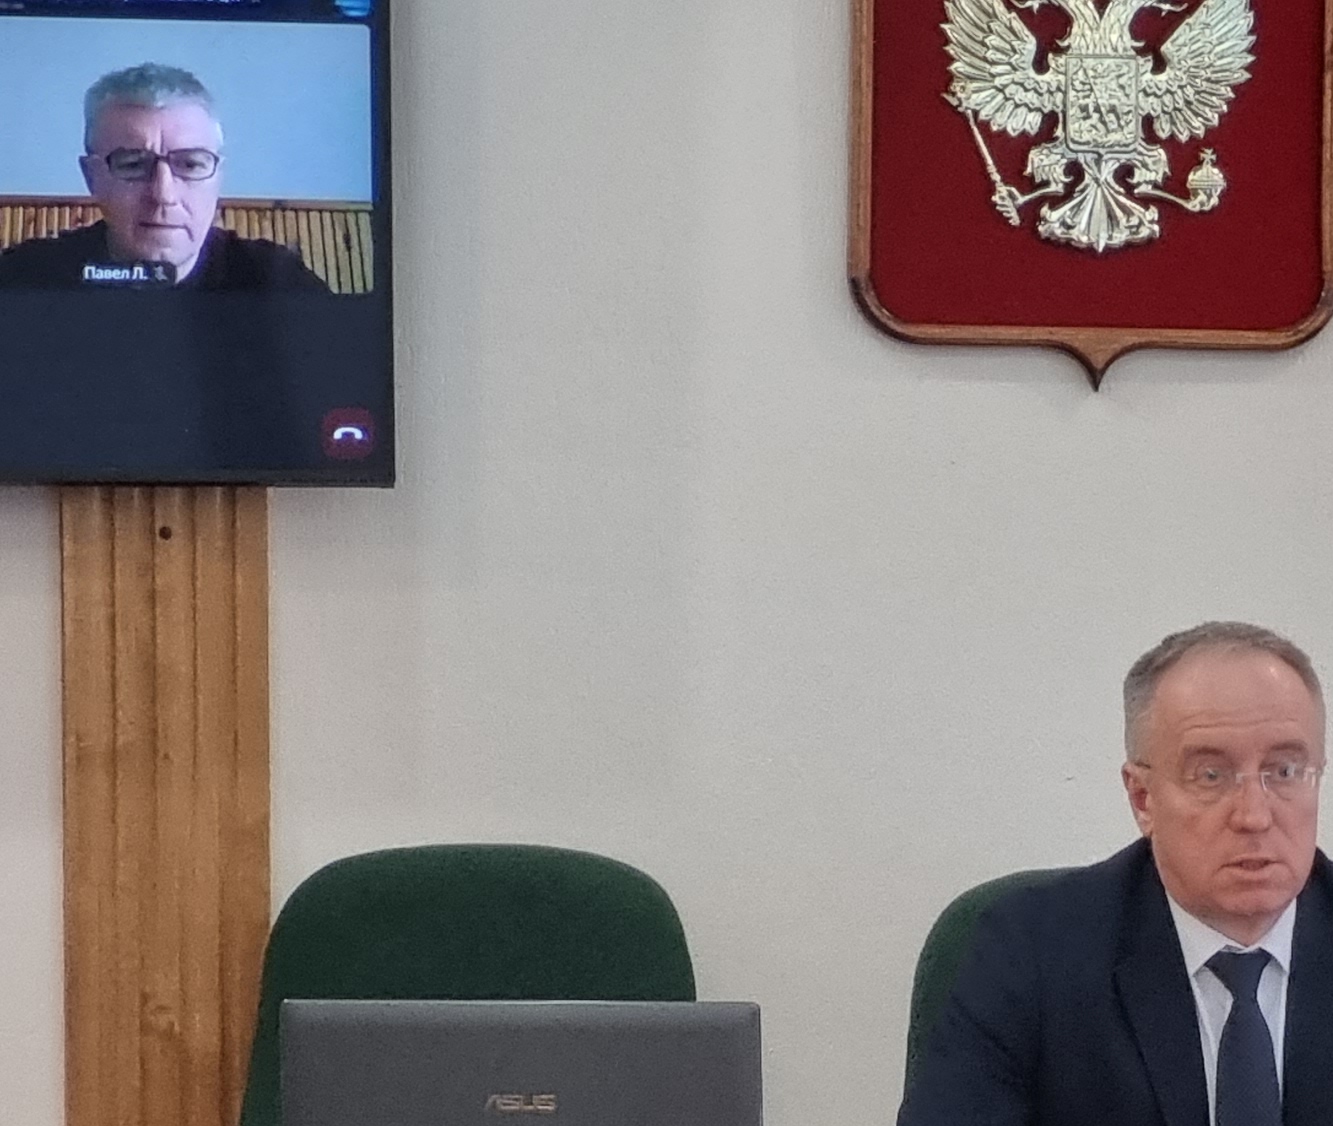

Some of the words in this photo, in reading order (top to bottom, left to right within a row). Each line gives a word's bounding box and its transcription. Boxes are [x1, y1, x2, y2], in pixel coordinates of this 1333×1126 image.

[84, 266, 130, 280] Павел
[132, 266, 148, 280] Л.
[484, 1093, 556, 1113] ASUS
